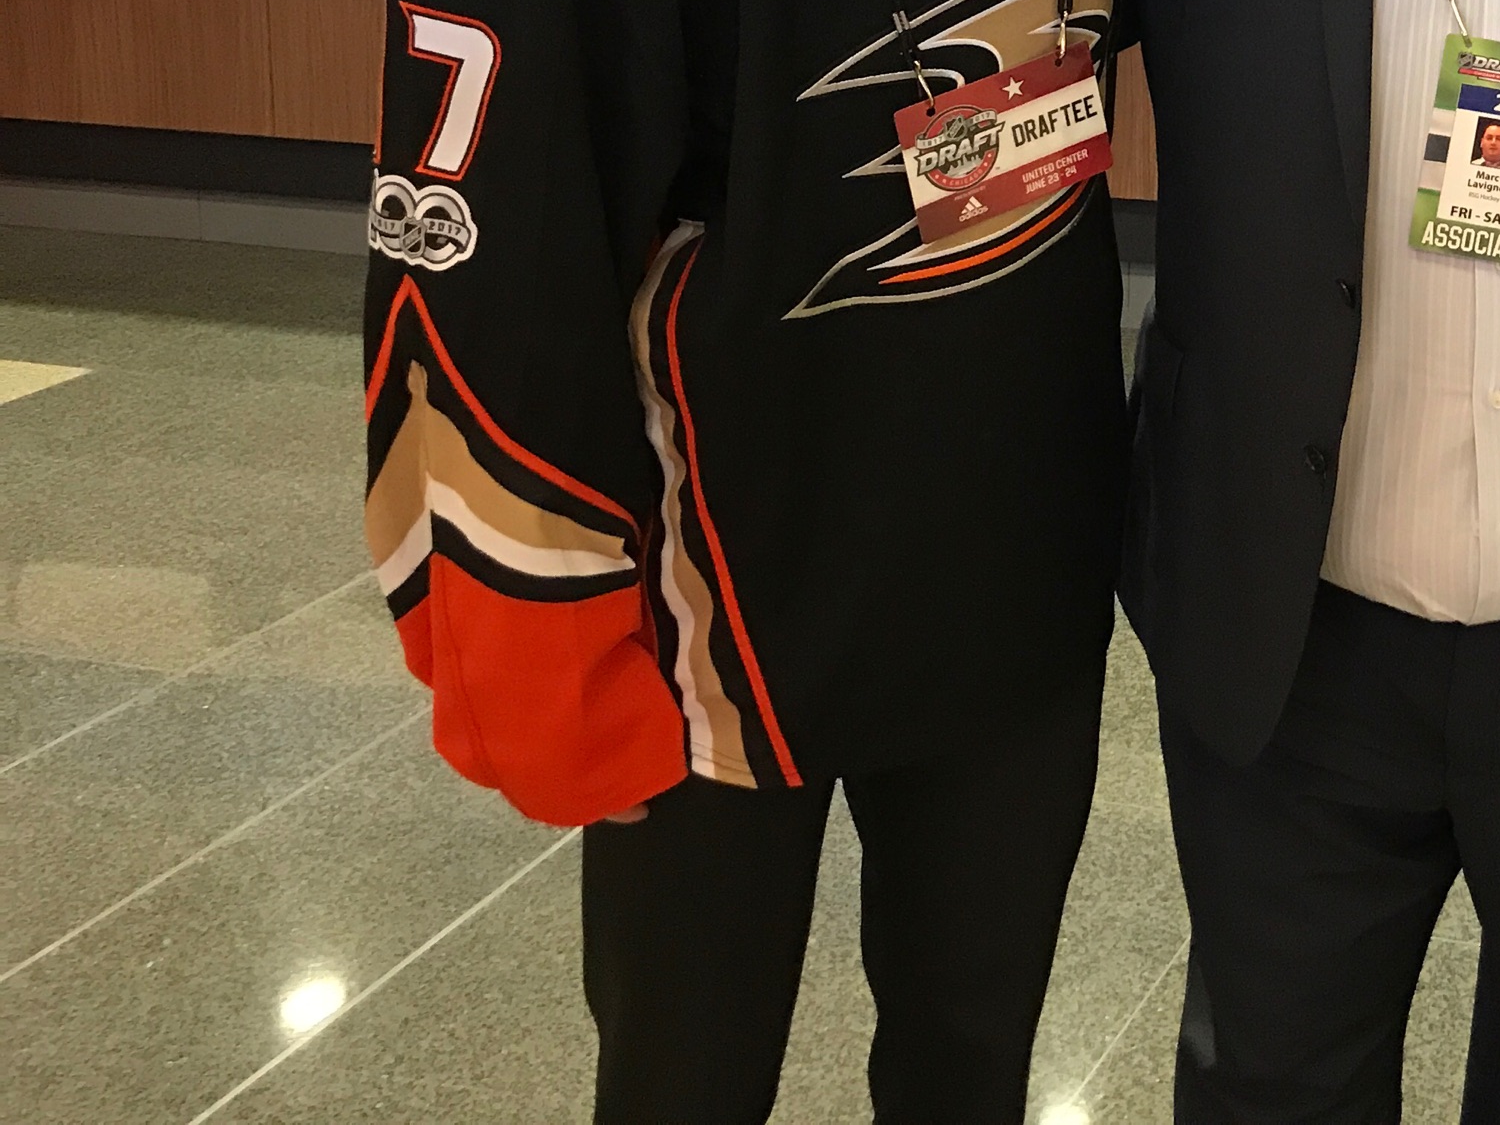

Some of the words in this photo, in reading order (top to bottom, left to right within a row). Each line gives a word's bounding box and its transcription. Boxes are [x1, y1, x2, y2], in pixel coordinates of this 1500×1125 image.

[1011, 94, 1098, 148] DRAFTEE
[917, 124, 1004, 175] DRAFT
[1022, 162, 1055, 183] UNITED
[1055, 148, 1089, 169] CENTER
[1026, 177, 1047, 194] JUNE
[1047, 172, 1060, 185] 23
[1065, 165, 1077, 177] 24
[1476, 170, 1500, 182] Marc
[1480, 193, 1500, 203] Hockey
[959, 205, 989, 222] adidas
[1450, 205, 1472, 220] FRI
[428, 220, 462, 236] 2017
